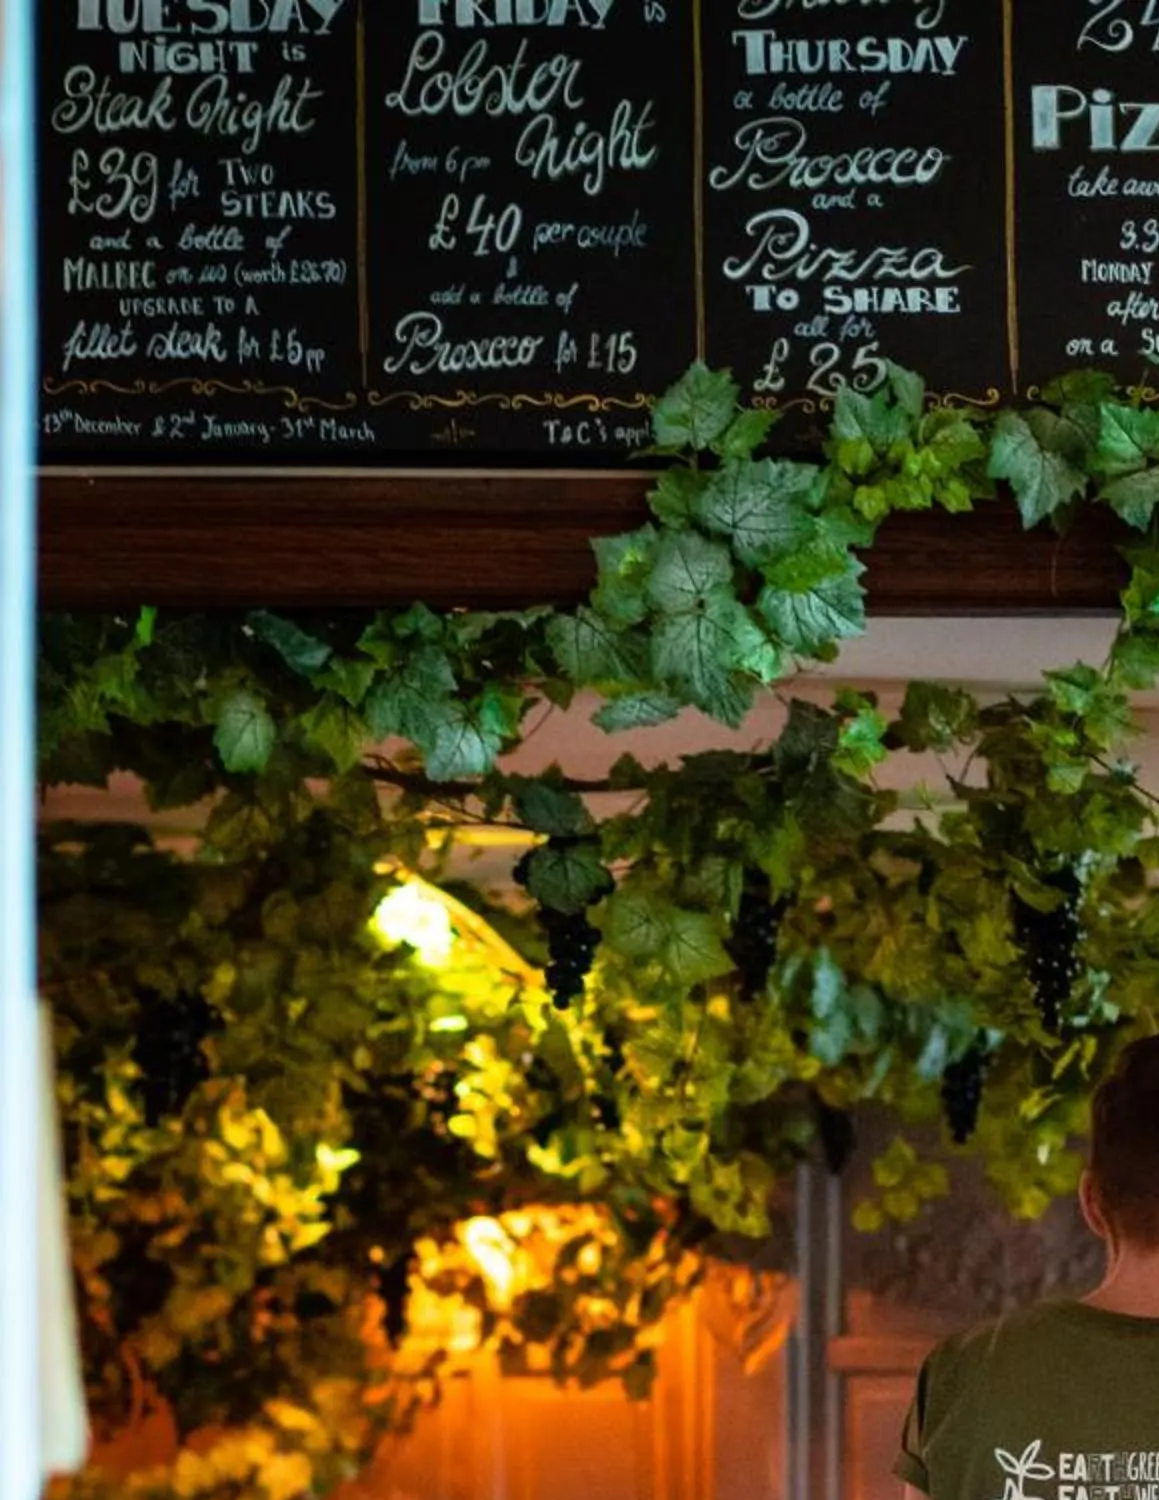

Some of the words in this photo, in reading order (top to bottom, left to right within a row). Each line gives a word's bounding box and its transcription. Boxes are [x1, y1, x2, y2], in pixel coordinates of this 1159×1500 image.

[77, 0, 345, 35] TUESDAY
[282, 41, 306, 61] is
[732, 29, 969, 75] THURSDAY
[385, 30, 584, 116] Lobster
[52, 65, 176, 133] Steak
[186, 74, 325, 154] Night
[733, 90, 754, 109] a
[768, 82, 845, 112] bottle
[859, 80, 892, 115] of
[389, 139, 437, 182] from
[515, 99, 657, 196] Night
[709, 116, 953, 190] Prosecco
[67, 147, 158, 223] £39
[169, 158, 199, 212] for
[1067, 164, 1118, 198] take
[220, 190, 337, 219] STEAKS
[812, 189, 855, 210] and
[867, 194, 884, 208] a
[89, 228, 132, 251] and
[146, 236, 163, 249] a
[178, 223, 245, 251] bottle
[265, 225, 293, 258] of
[429, 193, 523, 256] £40
[534, 221, 574, 253] per
[577, 208, 648, 257] couple
[723, 208, 975, 283] Pizza
[63, 257, 156, 292] MALBEC
[1081, 259, 1153, 284] MONDAY
[119, 297, 204, 317] UPGRADE
[212, 295, 235, 314] TO
[245, 295, 260, 316] A
[469, 290, 482, 304] a
[493, 283, 549, 305] bottle
[555, 281, 580, 314] of
[823, 285, 962, 315] SHARE
[62, 319, 138, 372] fillet
[146, 321, 228, 363] steak
[238, 326, 260, 364] for
[383, 310, 545, 374] Prosecco
[554, 329, 577, 373] for
[587, 331, 637, 373] £15
[793, 315, 829, 338] all
[840, 315, 876, 342] for
[1065, 338, 1095, 357] on
[1100, 340, 1120, 357] a
[74, 412, 142, 437] December
[319, 417, 375, 442] March
